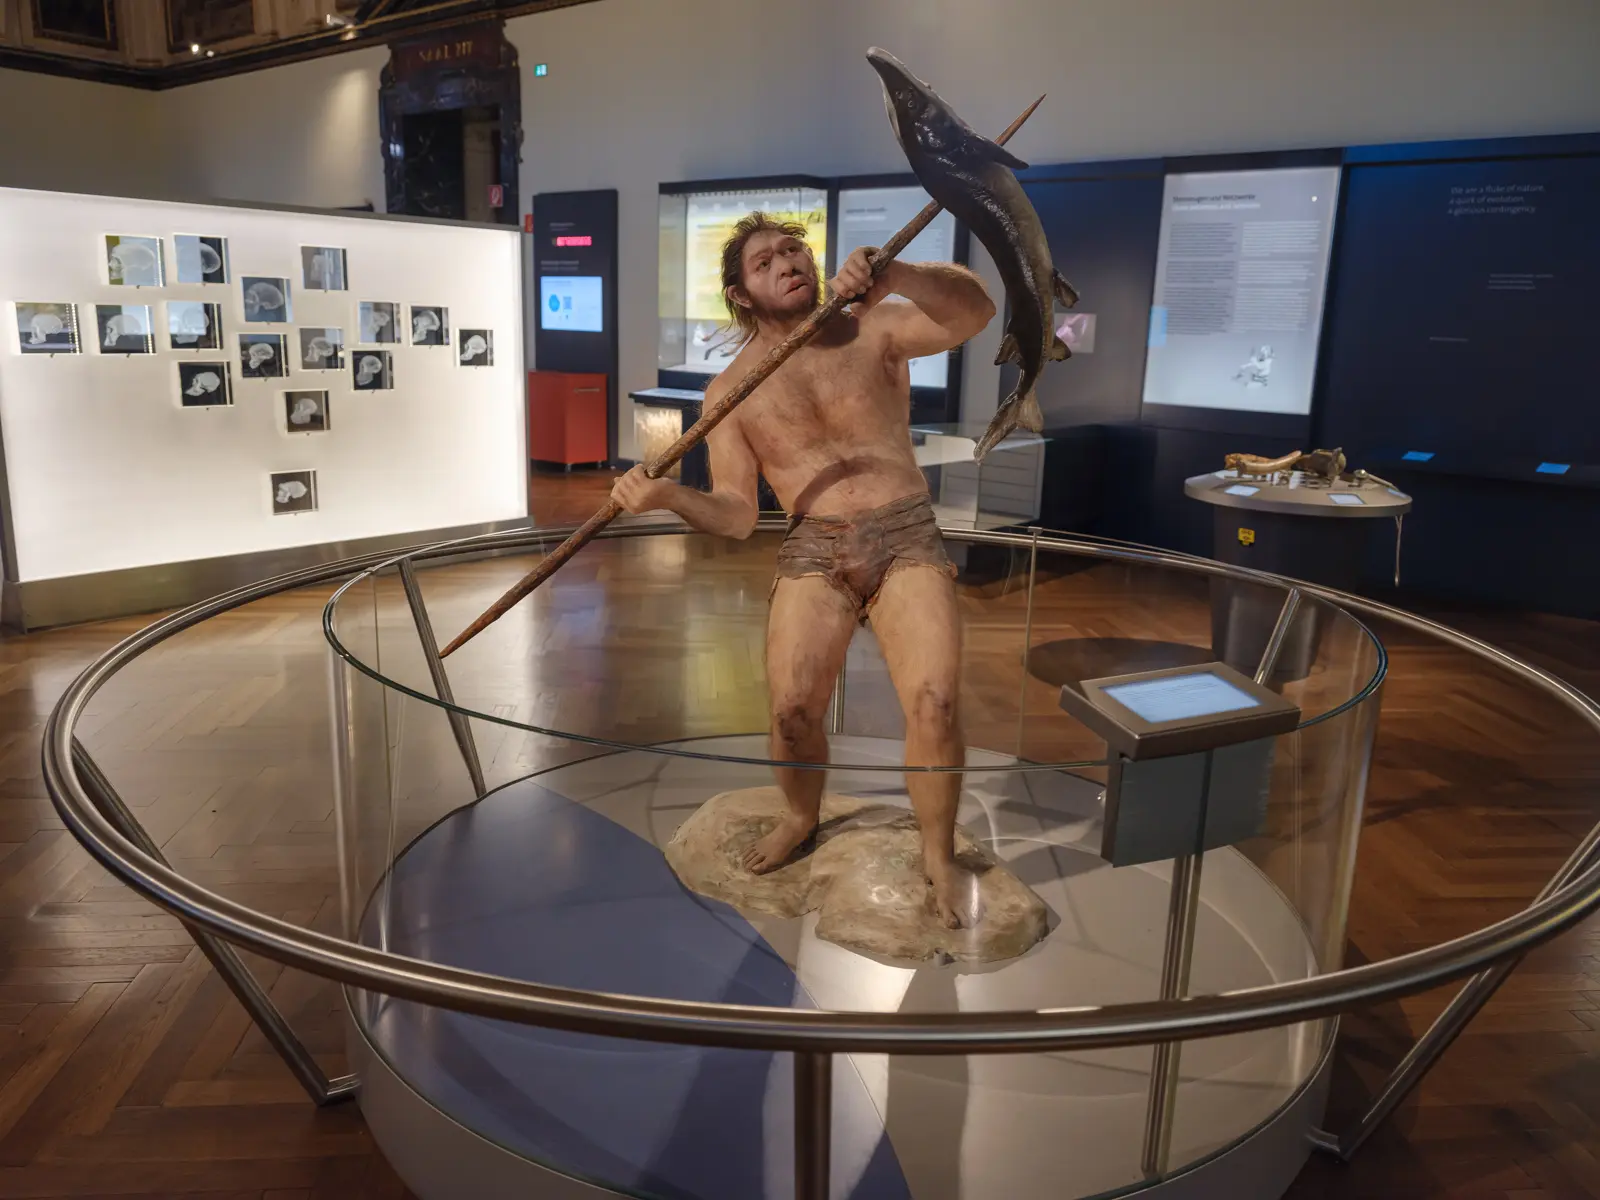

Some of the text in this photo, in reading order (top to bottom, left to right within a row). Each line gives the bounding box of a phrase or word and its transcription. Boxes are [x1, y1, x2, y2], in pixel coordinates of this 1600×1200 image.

[1450, 186, 1464, 194] We
[1506, 184, 1516, 193] of
[1477, 195, 1487, 204] of
